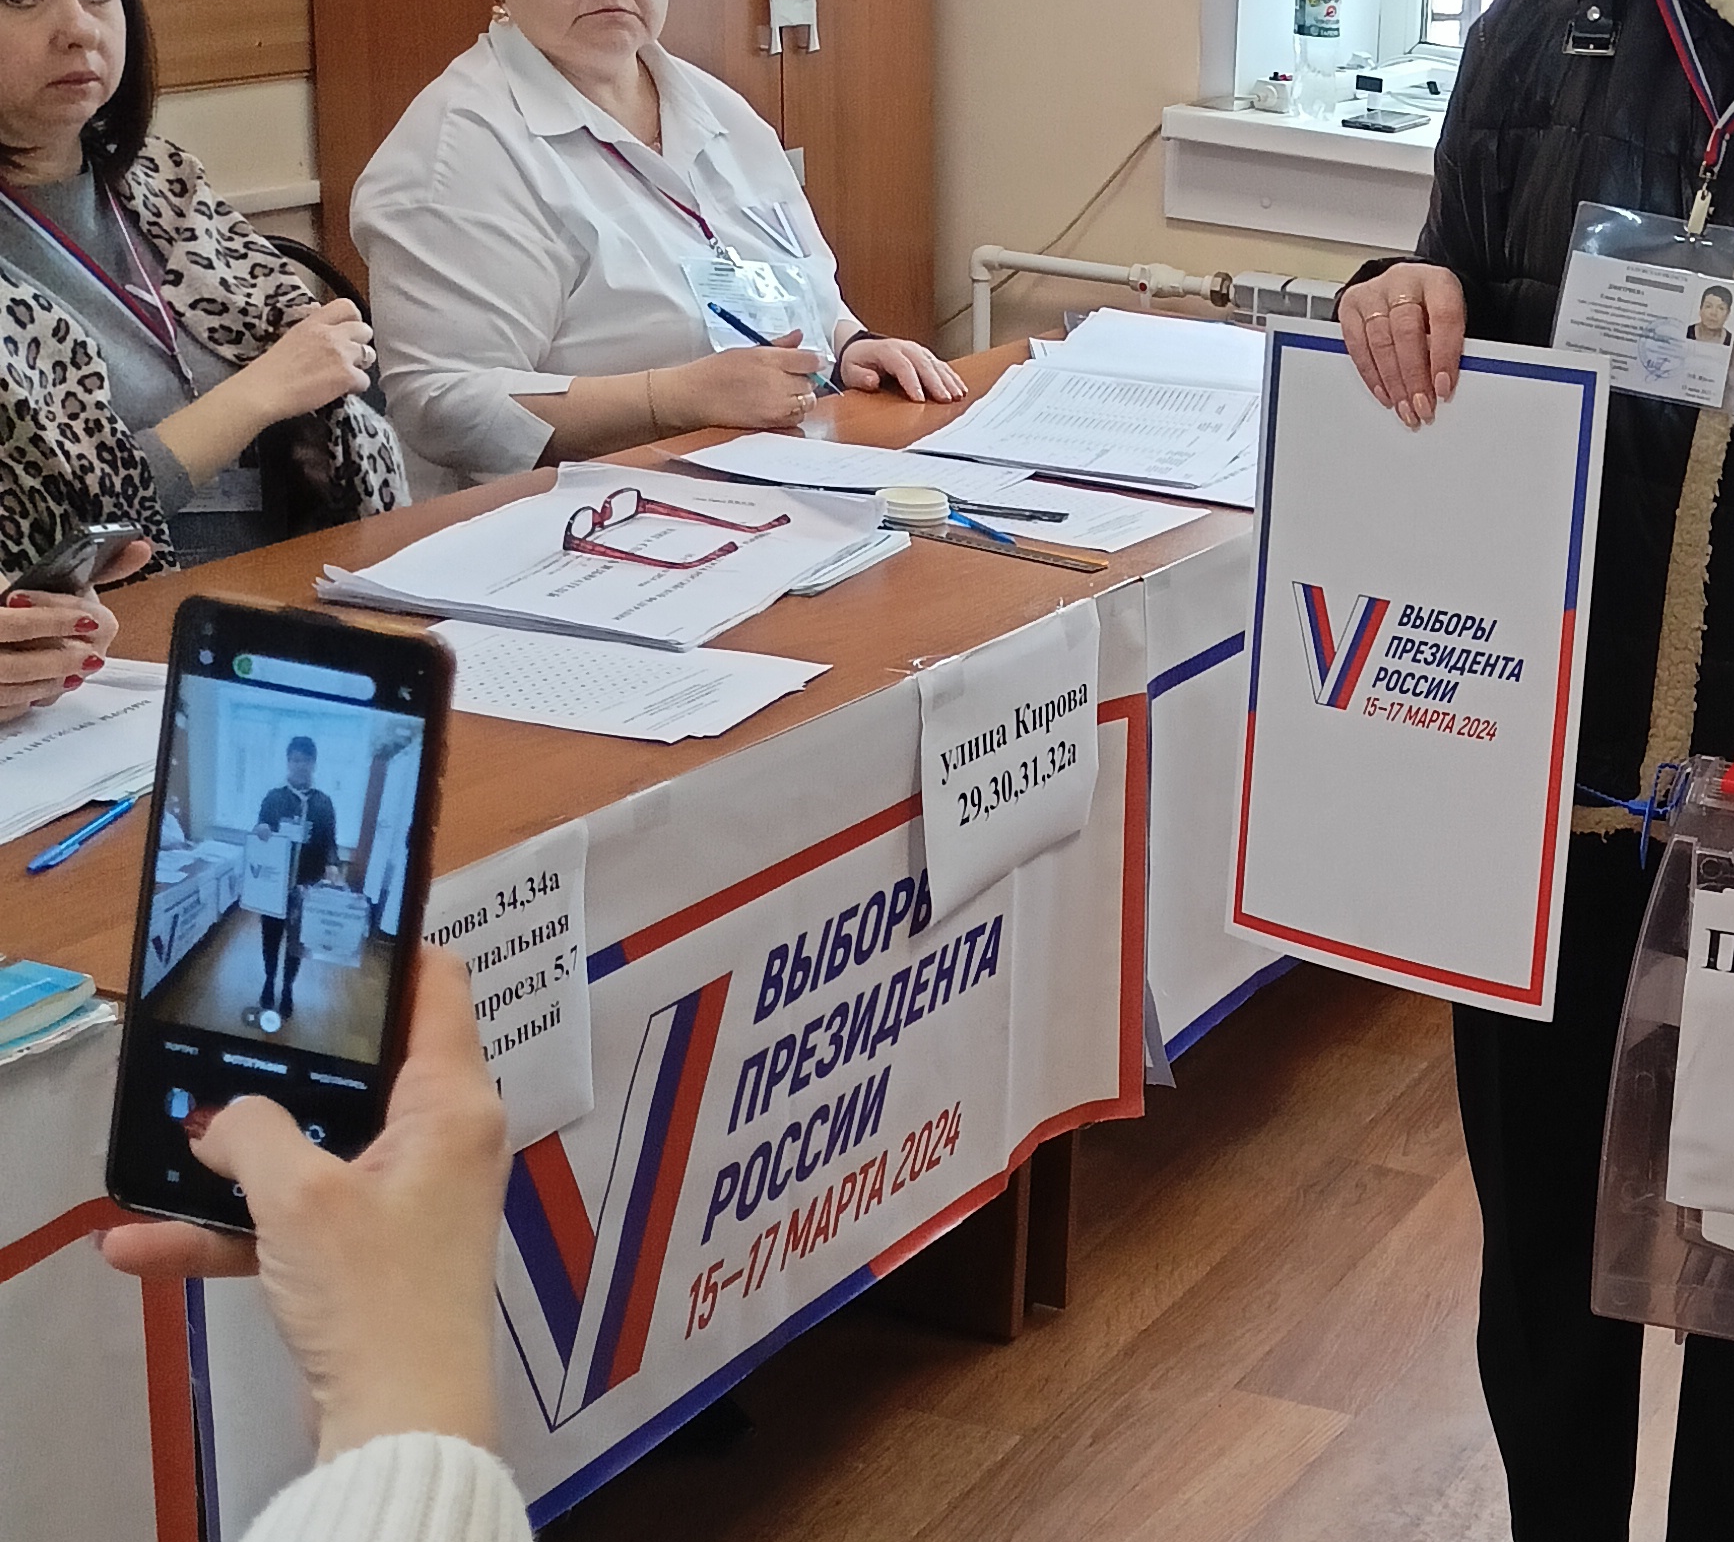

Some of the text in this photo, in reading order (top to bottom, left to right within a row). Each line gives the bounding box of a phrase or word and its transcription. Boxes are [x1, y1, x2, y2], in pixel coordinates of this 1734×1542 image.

[1398, 604, 1498, 642] ВЫБОРЫ
[1385, 635, 1524, 682] ПРЕЗИДЕНТА
[1372, 666, 1460, 704] РОССИИ
[940, 683, 1089, 785] улица Кирова
[1402, 704, 1457, 734] МАРТА
[1456, 715, 1498, 742] 2024
[495, 870, 561, 919] 34,34а
[475, 969, 548, 1022] проезд
[727, 915, 1004, 1135] ПРЕЗИДЕНТА
[701, 1065, 892, 1246] РОССИИ
[779, 1150, 889, 1272] МАРТА
[890, 1101, 962, 1196] 2024
